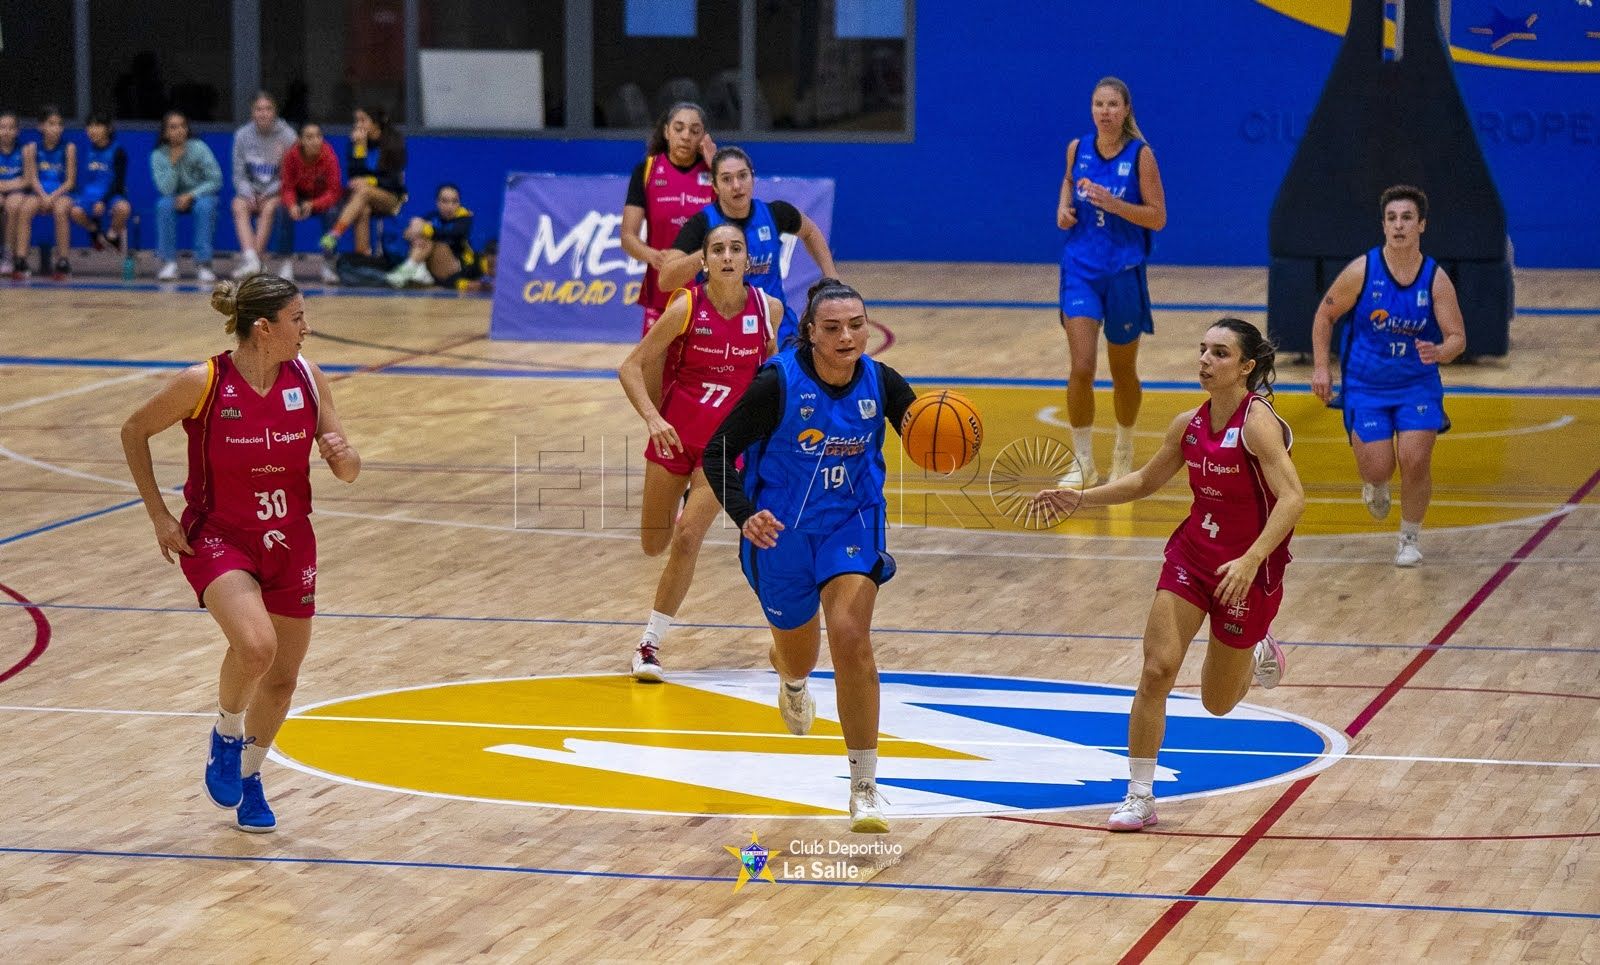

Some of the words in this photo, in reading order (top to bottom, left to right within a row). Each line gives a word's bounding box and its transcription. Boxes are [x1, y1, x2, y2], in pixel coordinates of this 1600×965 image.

[1096, 210, 1105, 227] 3
[524, 280, 617, 304] CIUDAD
[1389, 342, 1407, 357] 17
[699, 382, 732, 408] 77
[272, 428, 307, 444] Cajasol
[820, 465, 846, 490] 19
[1207, 461, 1240, 475] Cajasol
[254, 488, 288, 521] 30
[1201, 513, 1220, 539] 4
